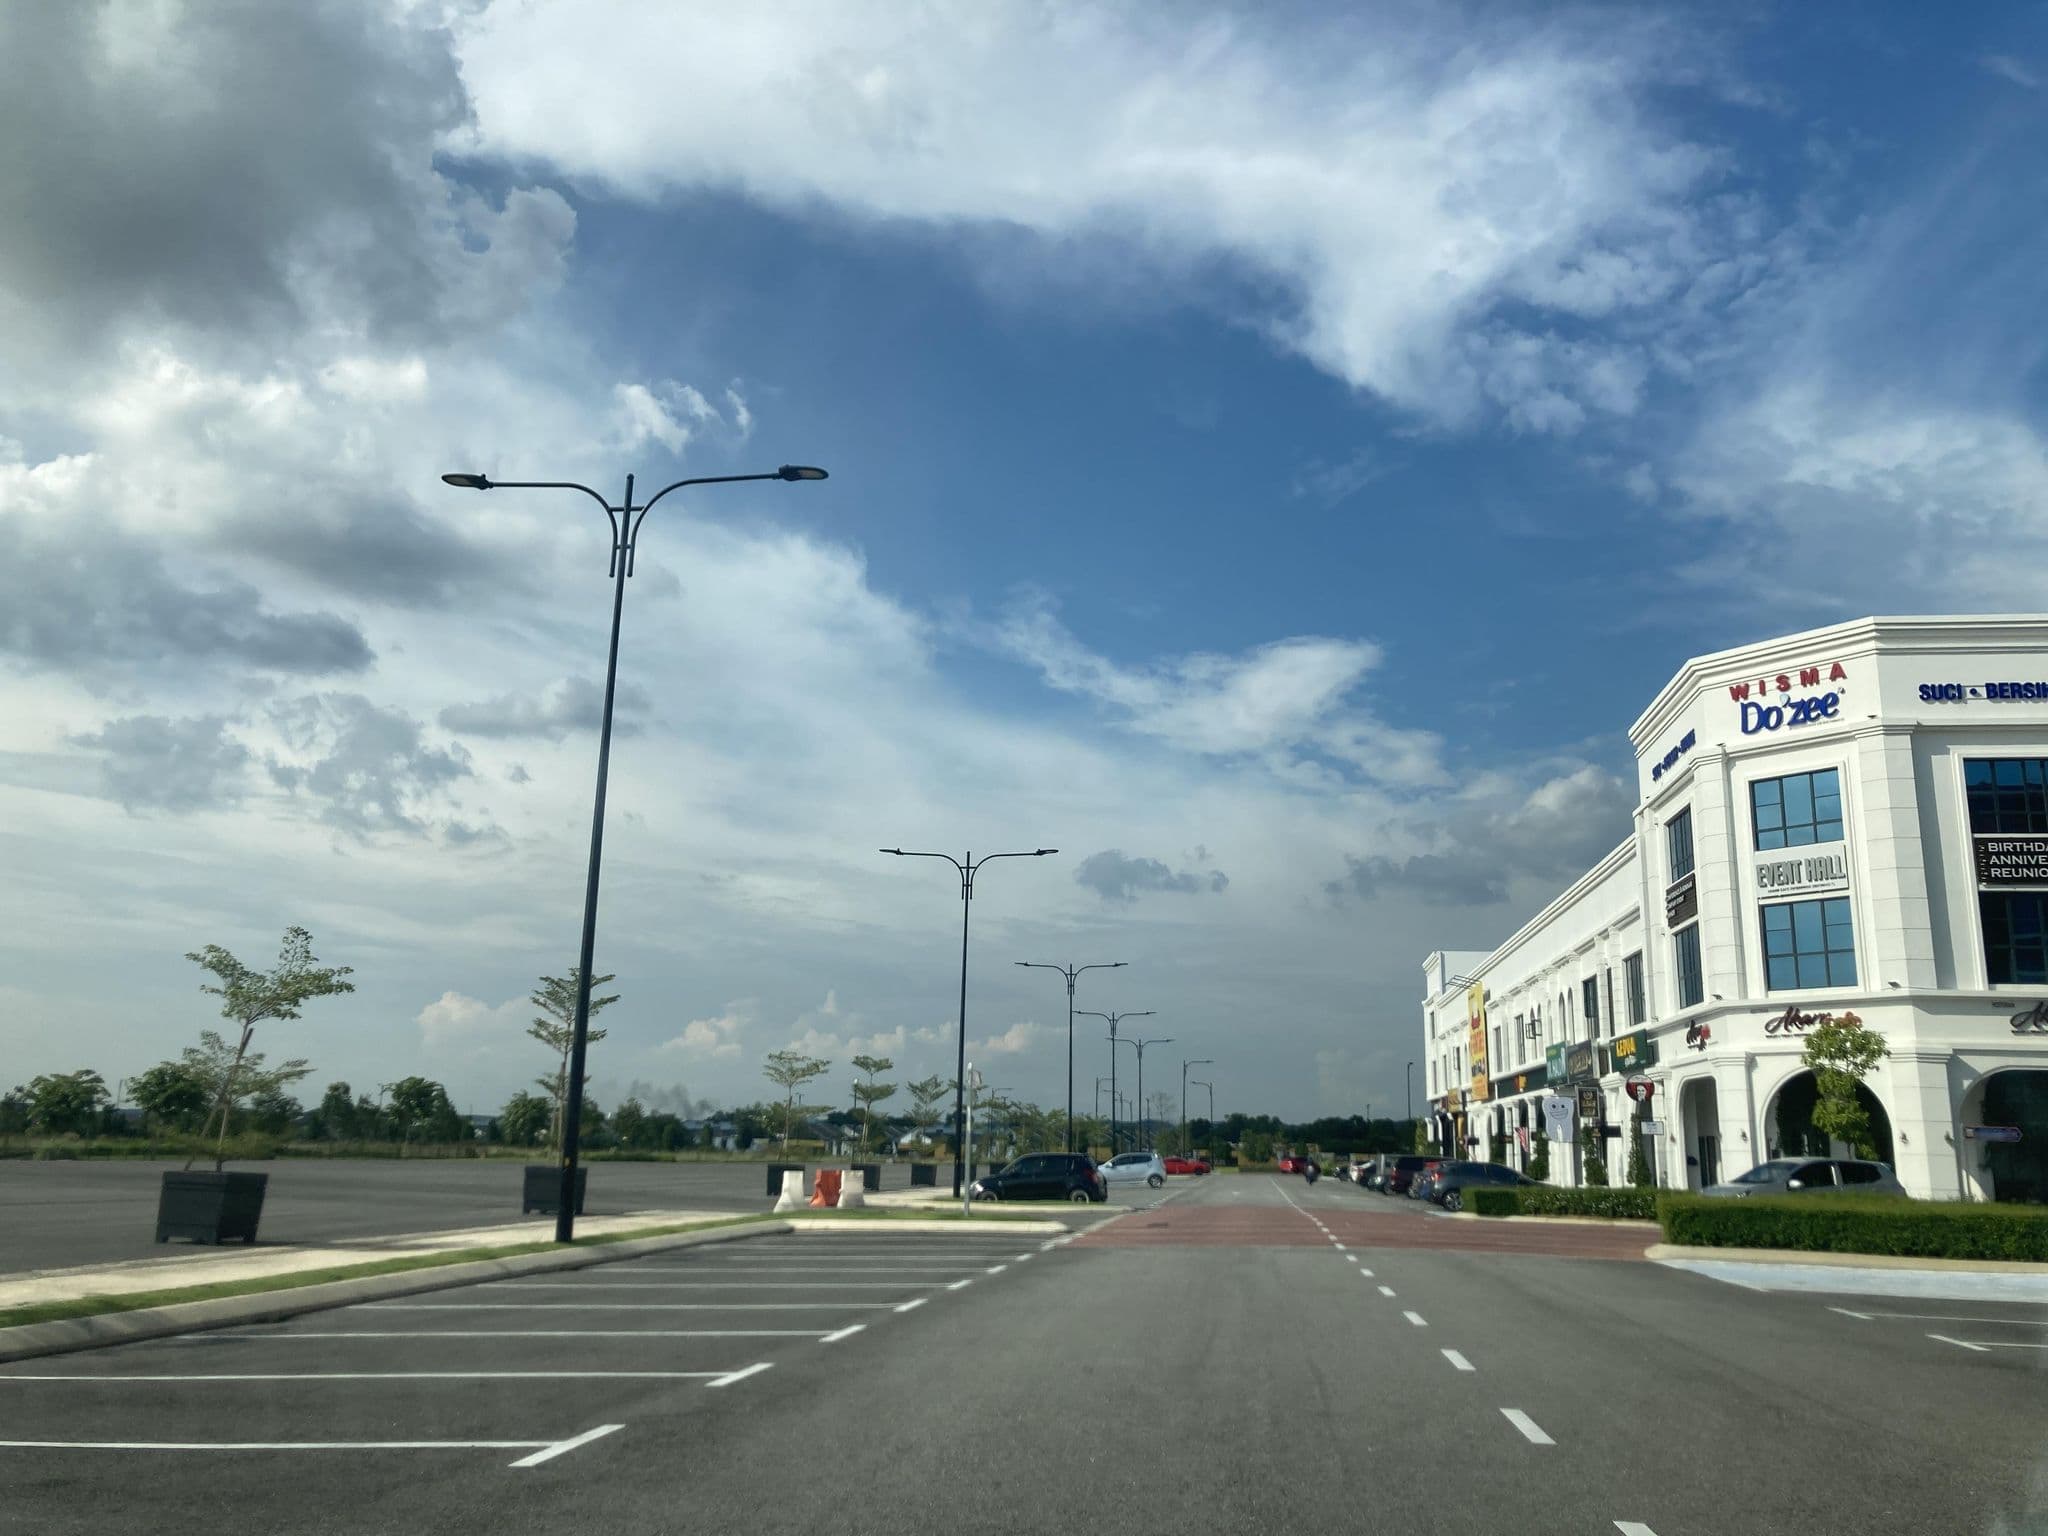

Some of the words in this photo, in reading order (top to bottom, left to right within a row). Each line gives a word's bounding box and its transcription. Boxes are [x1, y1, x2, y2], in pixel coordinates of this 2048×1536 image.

[1729, 661, 1848, 702] WISMA
[1919, 682, 1964, 702] SUCI
[1987, 842, 2048, 852] BIRTHD
[1989, 855, 2048, 865] ANNIVE
[1756, 860, 1803, 888] EVENT
[1804, 855, 1847, 882] HALL
[1990, 867, 2048, 878] REUNIO
